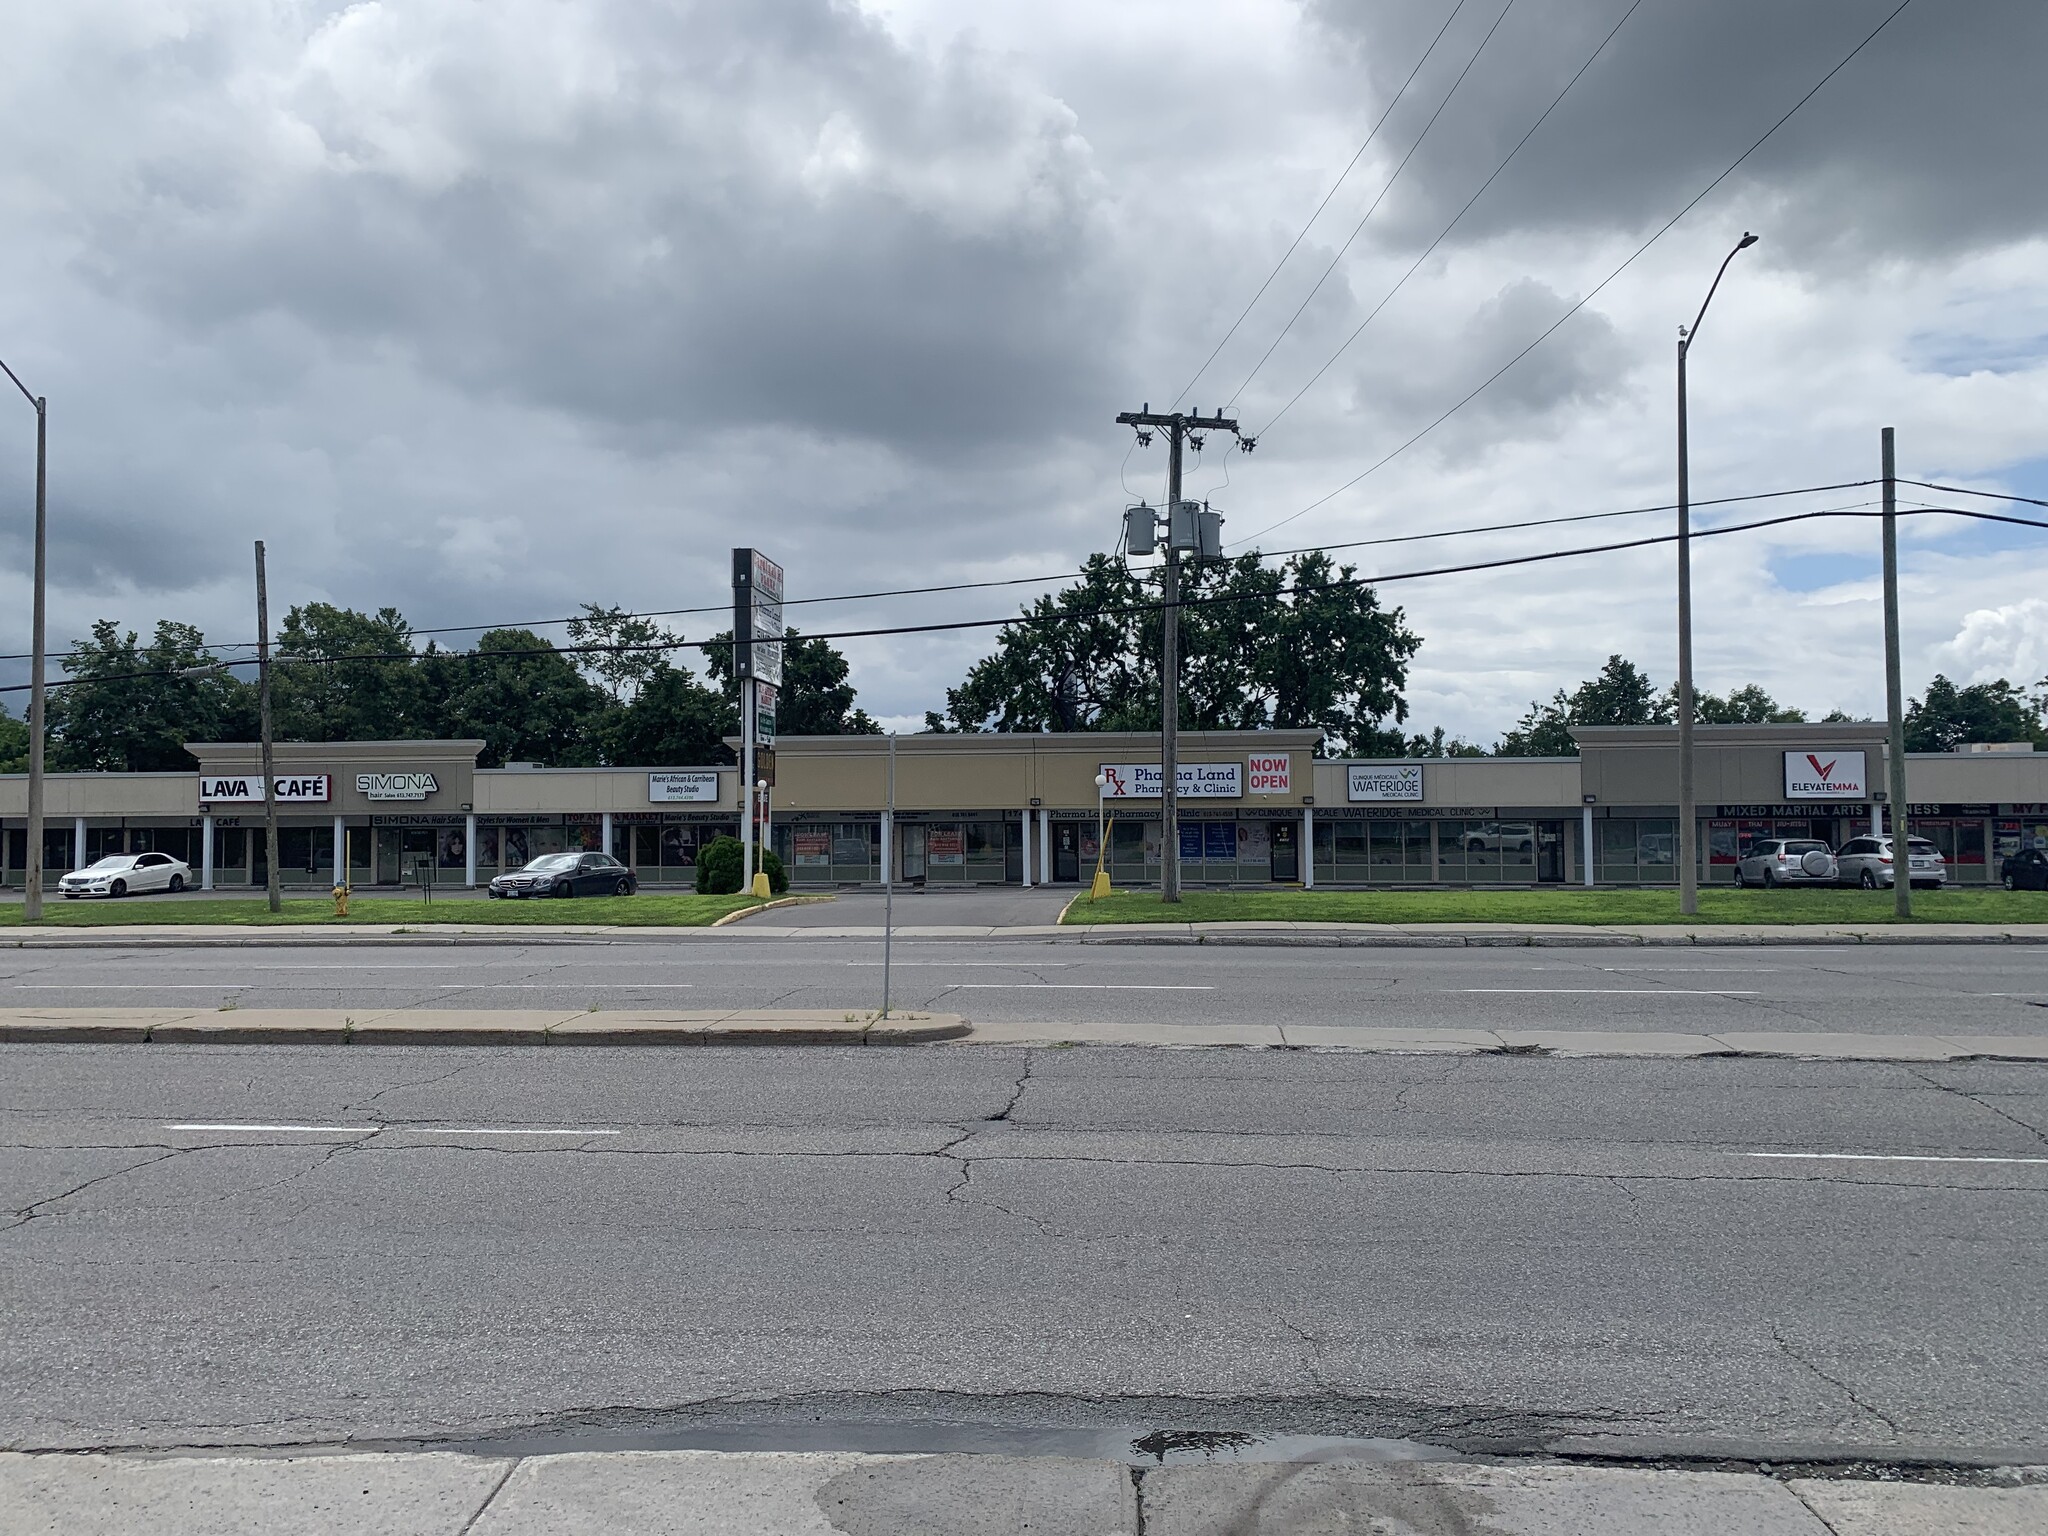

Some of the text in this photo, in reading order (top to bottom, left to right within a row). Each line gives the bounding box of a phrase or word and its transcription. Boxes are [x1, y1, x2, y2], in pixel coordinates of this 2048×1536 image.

[1250, 759, 1287, 772] NOW
[692, 774, 715, 782] Carribean
[1135, 768, 1193, 781] Phaa
[1197, 768, 1235, 780] Land
[202, 776, 323, 797] LAVA CAFÉ
[358, 775, 435, 790] SIMONA
[1251, 775, 1288, 788] OPEN
[1353, 780, 1418, 792] WATERIDGE
[1792, 783, 1859, 791] ELEVATEMMA
[666, 785, 699, 794] Beauty Studio
[1135, 784, 1236, 795] Pharcy & Clinic
[1050, 810, 1085, 818] Pharma
[1114, 809, 1160, 820] Pharmacy
[1258, 809, 1292, 817] CLINIQUE
[1343, 808, 1402, 818] WATERIDGE
[1408, 808, 1445, 817] MEDICAL
[1450, 808, 1475, 817] CLINIC
[1724, 806, 1767, 816] MIXED
[1772, 806, 1827, 816] MARTIAL
[1832, 805, 1863, 816] ARTS
[216, 817, 239, 826] CAFÉ
[374, 816, 429, 825] SIMONA
[431, 816, 446, 824] Hair
[477, 816, 496, 825] Styles
[497, 816, 505, 825] for
[507, 816, 529, 824] Women
[622, 813, 658, 821] MARKET
[665, 813, 685, 821] Marie's
[688, 813, 707, 822] Beauty
[709, 813, 729, 821] Studio
